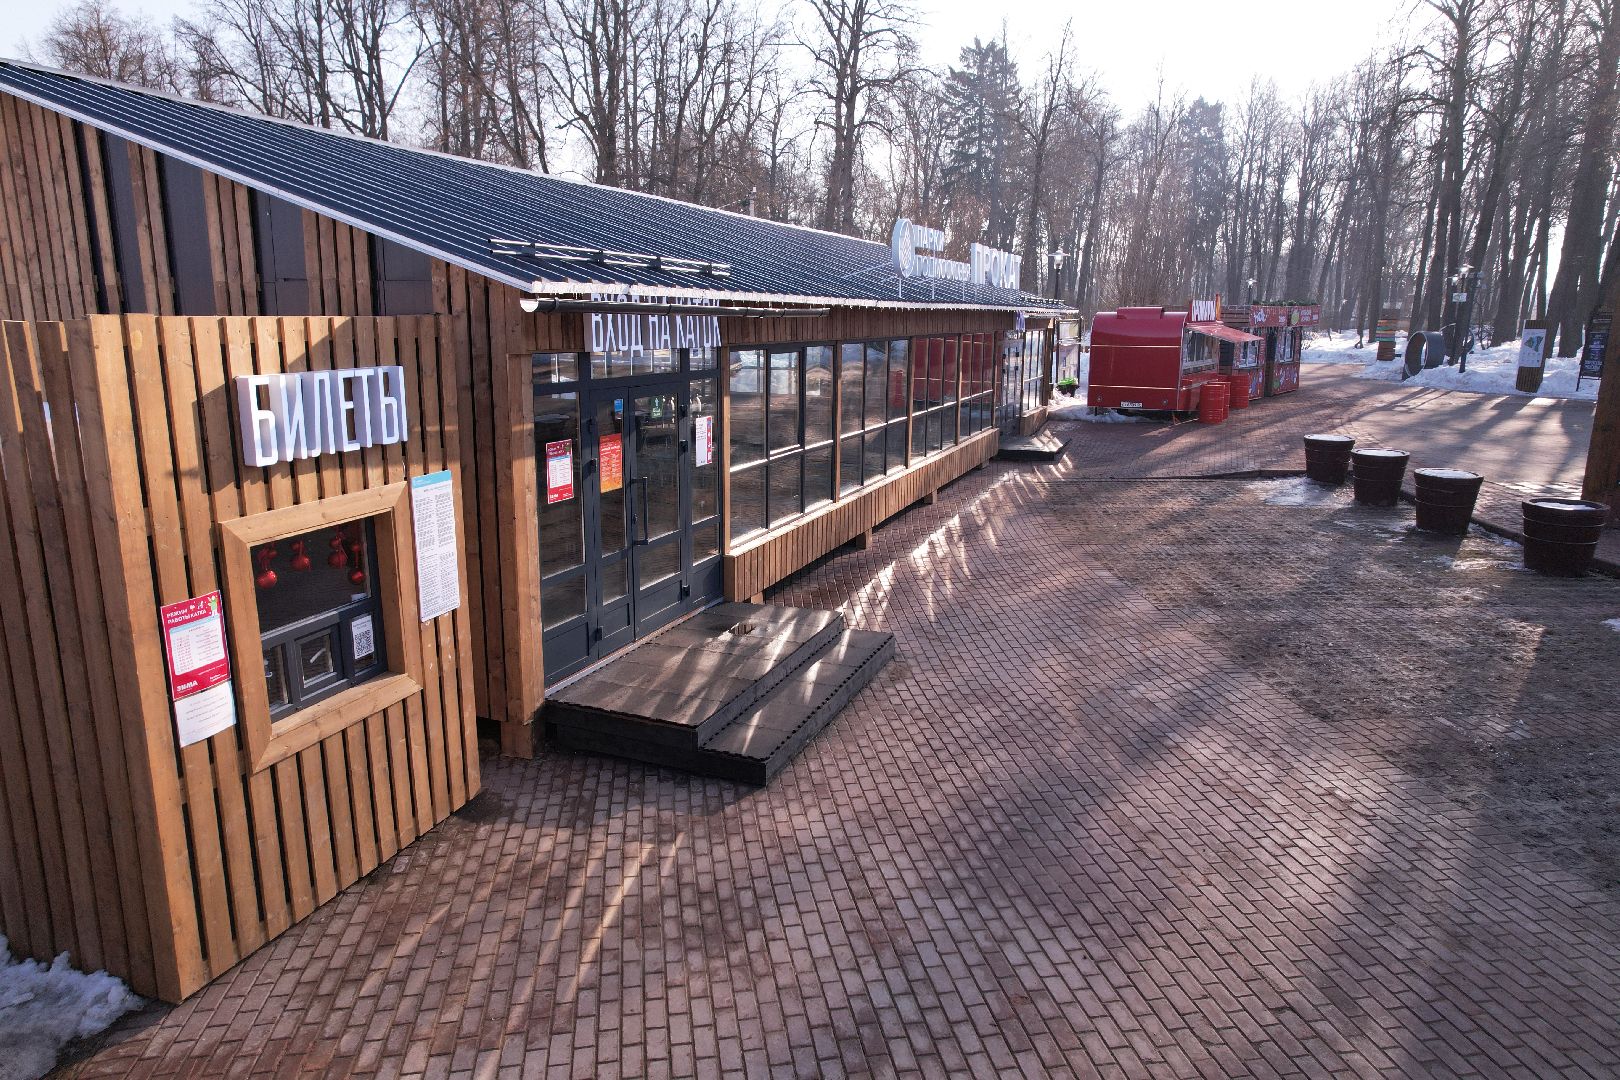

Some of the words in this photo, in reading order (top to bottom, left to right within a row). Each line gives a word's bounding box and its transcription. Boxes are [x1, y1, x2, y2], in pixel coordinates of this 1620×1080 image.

[914, 225, 945, 252] ПАРКИ
[971, 242, 1022, 290] ПРОКАТ
[590, 293, 644, 358] ВХОД
[647, 296, 671, 350] НА
[675, 297, 722, 349] КАТОК
[237, 366, 408, 468] БИЛЕТЫ
